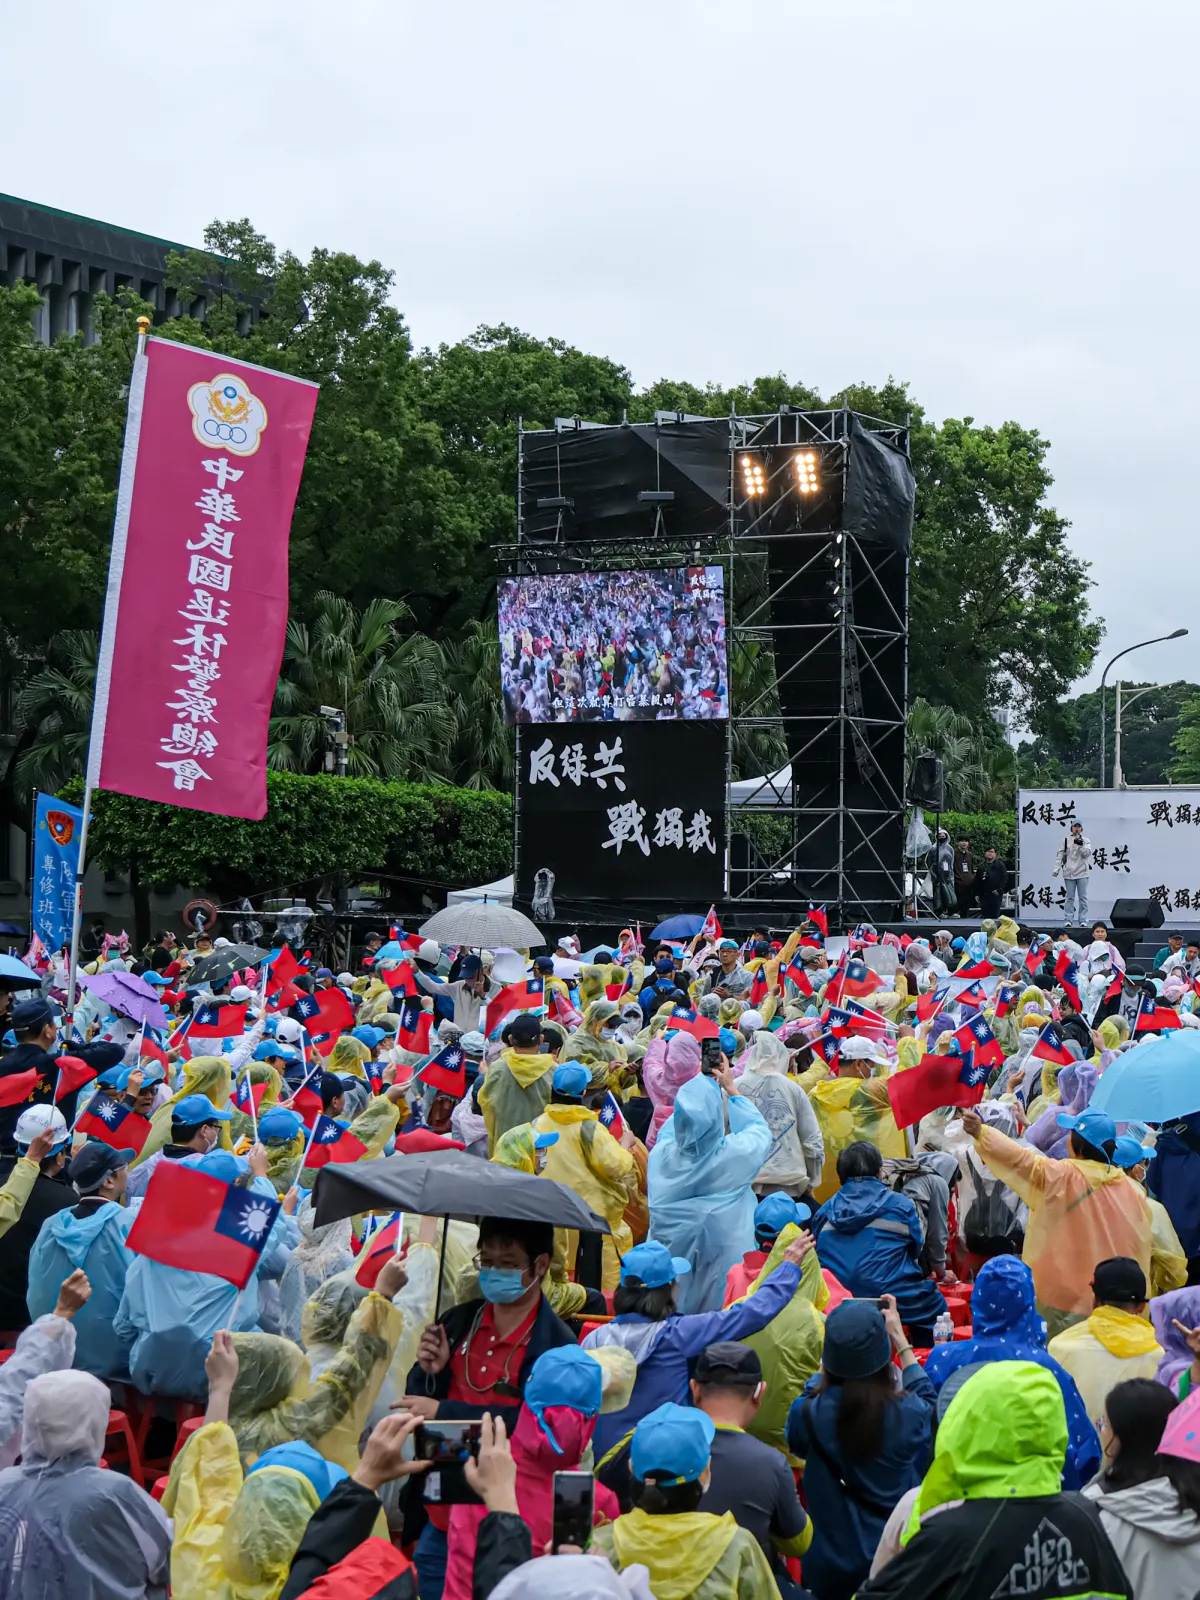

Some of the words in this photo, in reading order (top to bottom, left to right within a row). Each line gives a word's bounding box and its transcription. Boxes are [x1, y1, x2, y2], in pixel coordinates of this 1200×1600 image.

[529, 735, 626, 792] 反綠共
[601, 799, 717, 856] 戰獨裁
[1022, 800, 1076, 827] 反綠共
[1089, 844, 1131, 873] 綠共
